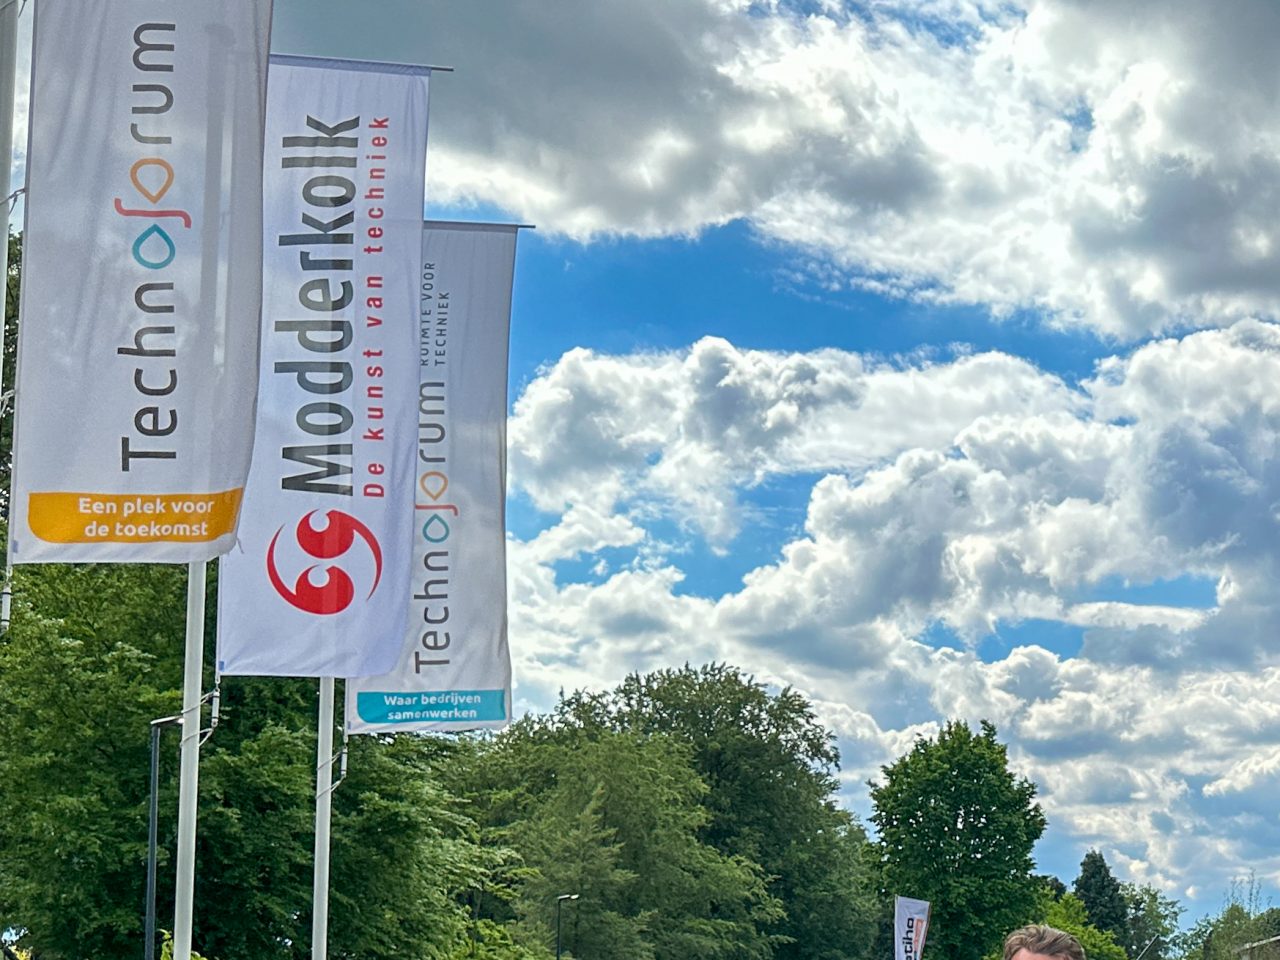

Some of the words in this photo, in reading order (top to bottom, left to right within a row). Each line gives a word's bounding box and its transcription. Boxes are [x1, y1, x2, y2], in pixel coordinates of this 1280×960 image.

[363, 117, 390, 254] techniek
[114, 22, 192, 472] Technoforum
[274, 115, 360, 497] Modderkolk
[366, 276, 383, 328] van
[422, 262, 436, 301] VOOR
[421, 309, 432, 367] RUIMTE
[435, 292, 450, 367] TECHNIEK
[363, 349, 384, 441] kunst
[78, 497, 117, 514] Een
[123, 498, 166, 517] plek
[171, 501, 215, 513] voor
[363, 463, 385, 498] De
[85, 520, 109, 537] de
[115, 520, 208, 537] toekomst
[414, 381, 459, 674] Technoforum
[384, 695, 418, 706] Waar
[421, 692, 481, 706] bedrijven
[387, 708, 477, 720] samenwerken
